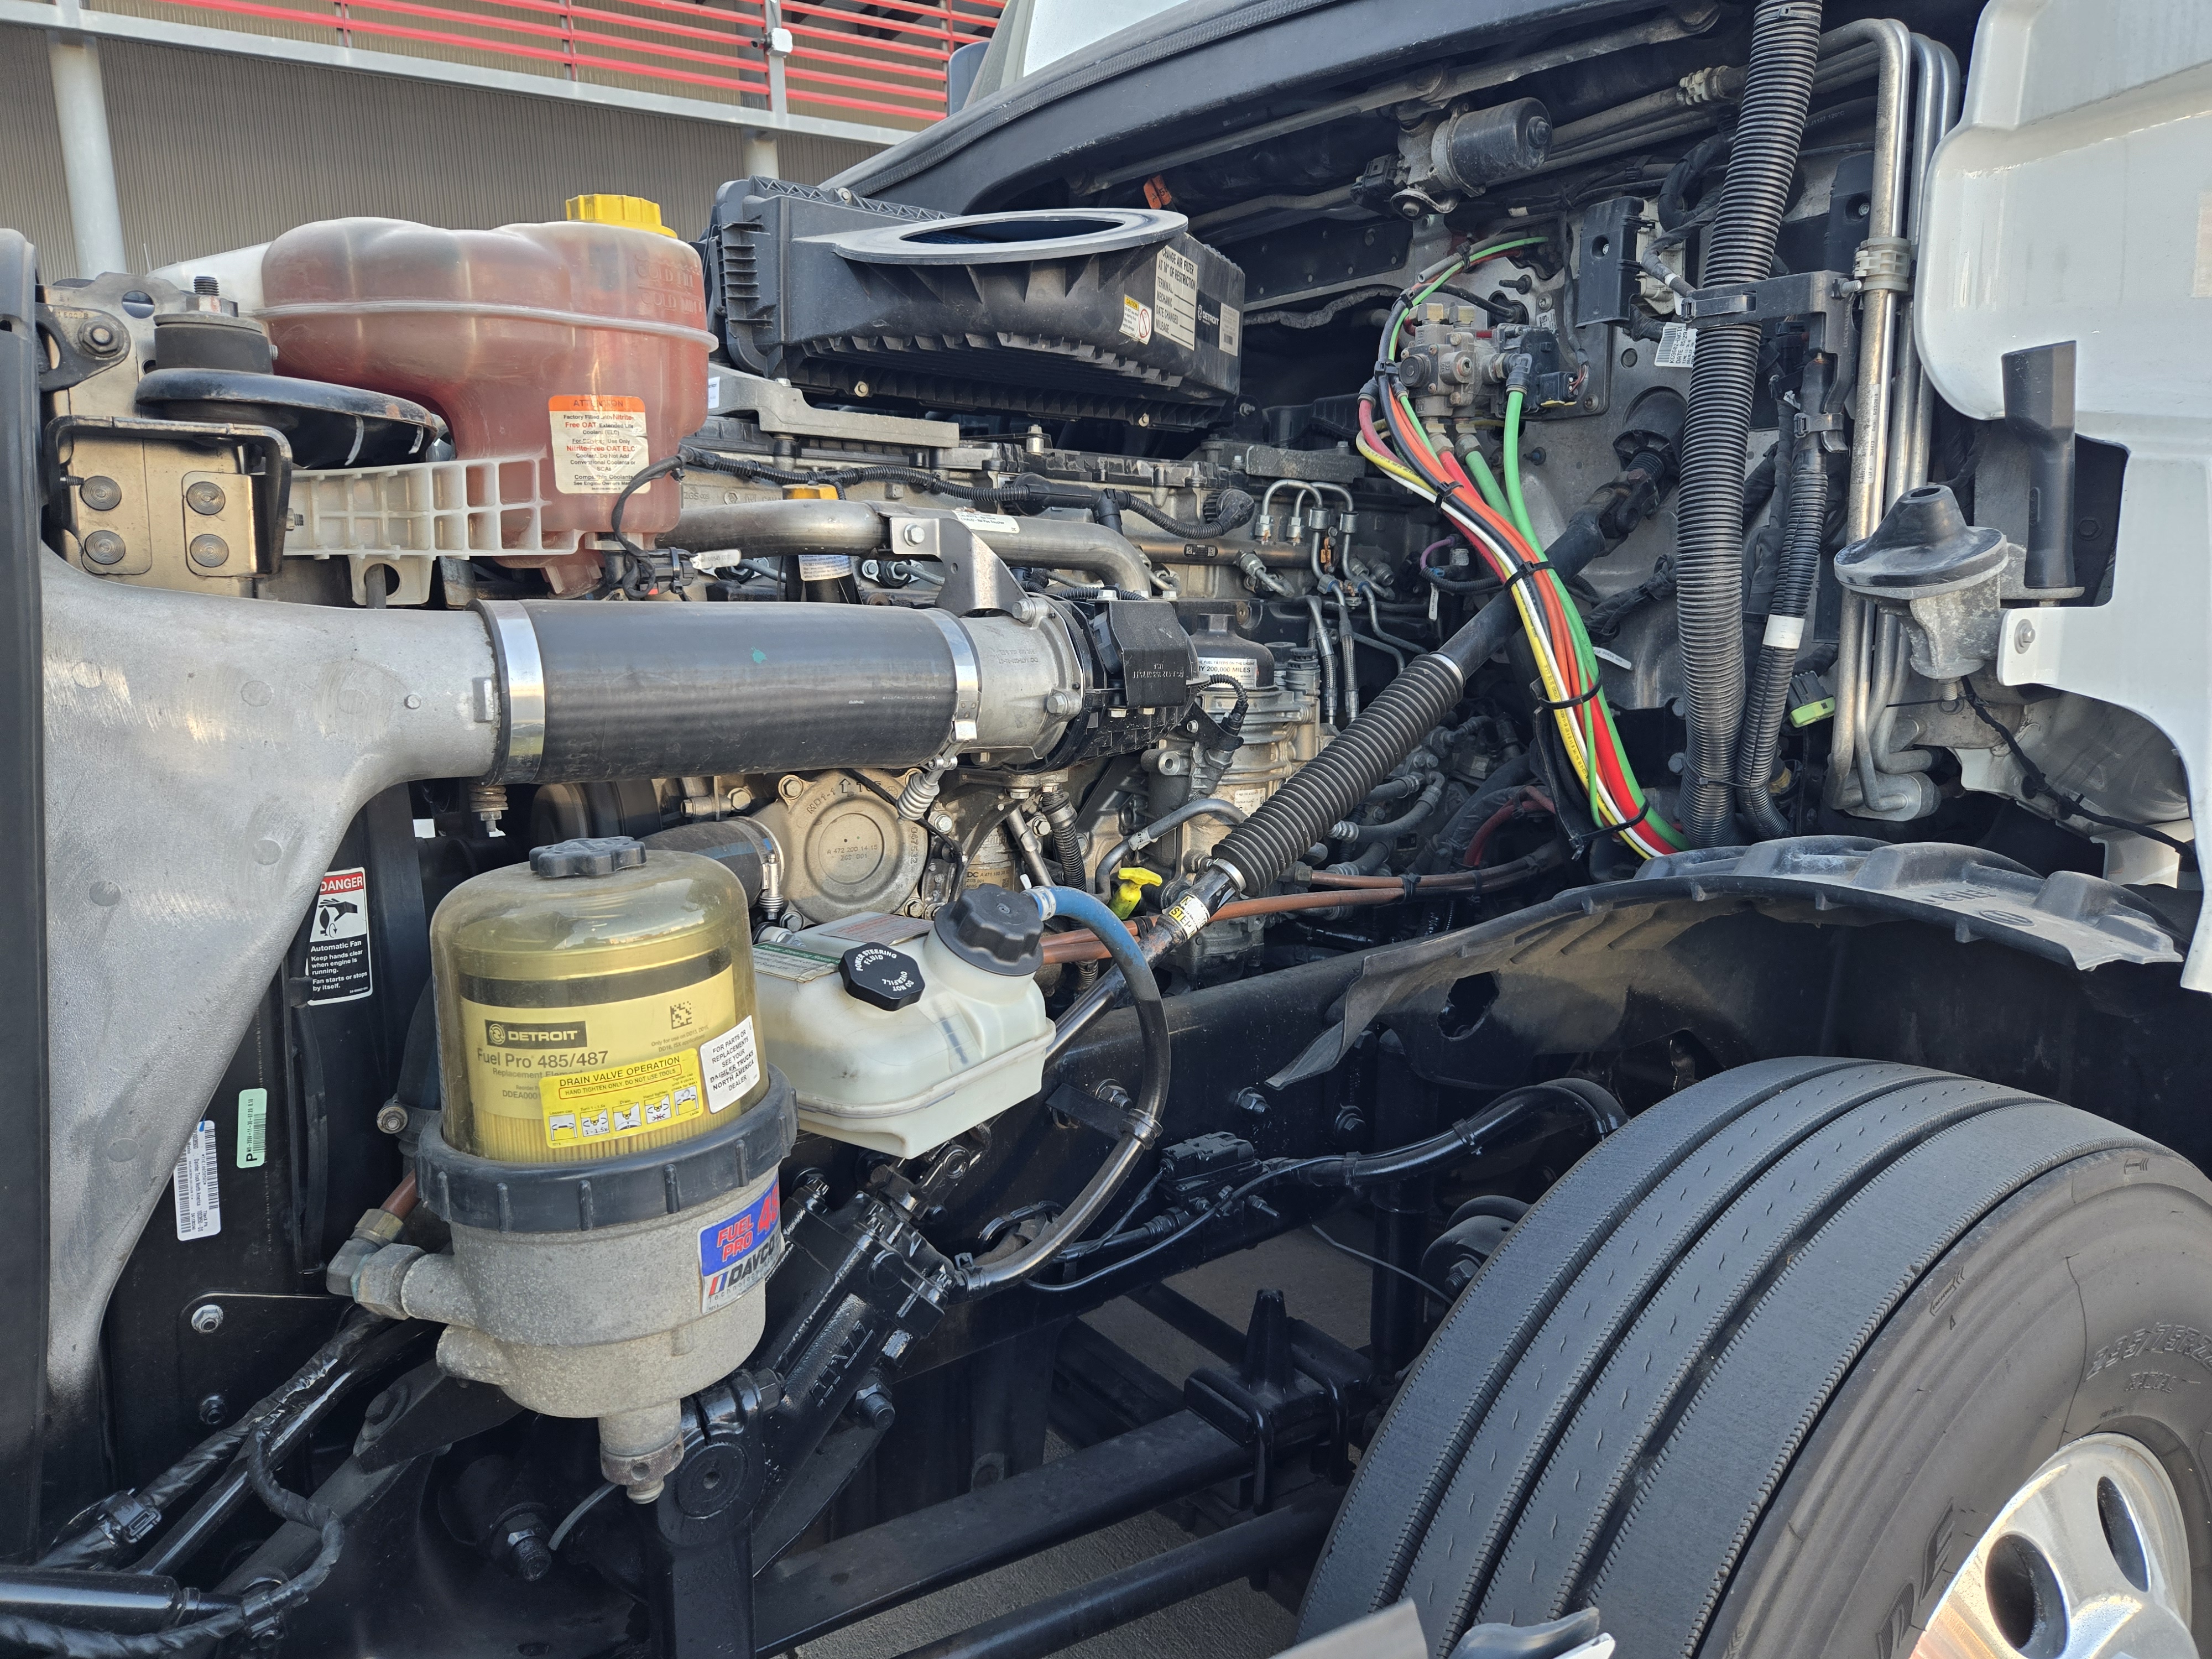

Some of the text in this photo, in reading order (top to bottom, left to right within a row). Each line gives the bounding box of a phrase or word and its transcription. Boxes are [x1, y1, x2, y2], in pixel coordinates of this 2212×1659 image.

[1159, 259, 1163, 270] AT
[1170, 266, 1174, 278] OF
[1175, 269, 1196, 291] RESTRICTION
[1184, 260, 1194, 275] FILTER
[1157, 276, 1173, 294] TERMINAL
[1126, 299, 1138, 309] CAUTION
[1157, 290, 1172, 307] MECHANIC
[1165, 309, 1178, 325] CHANGED
[1202, 311, 1219, 326] DETROIT
[1156, 319, 1169, 333] MILEAGE
[320, 876, 363, 891] DANGER
[1171, 907, 1192, 927] STEP
[311, 942, 348, 952] Automatic
[782, 948, 812, 958] Steering
[854, 949, 897, 971] POWER STEERING
[864, 954, 884, 966] FLUID
[881, 971, 907, 985] OVERFILL
[508, 1030, 578, 1041] DETROIT
[713, 1030, 746, 1053] FOR PARTS OR
[477, 1047, 608, 1068] Fuel Pro 485/487
[712, 1036, 749, 1064] REPLACEMENTS
[722, 1048, 745, 1067] SEE YOUR
[737, 1050, 754, 1066] TRUCKS
[493, 1068, 542, 1078] Replacement
[560, 1056, 680, 1087] DRAIN VALVE OPERATION
[713, 1060, 754, 1091] NORTH AMERICA
[583, 1085, 607, 1093] TIGHTEN
[659, 1068, 676, 1077] TOOLS
[728, 1076, 747, 1091] DEALER
[503, 1090, 539, 1099] DDEA000
[246, 1153, 257, 1162] P
[717, 1214, 754, 1248] FUEL
[723, 1230, 753, 1262] PRO
[728, 1234, 774, 1287] DAYCO
